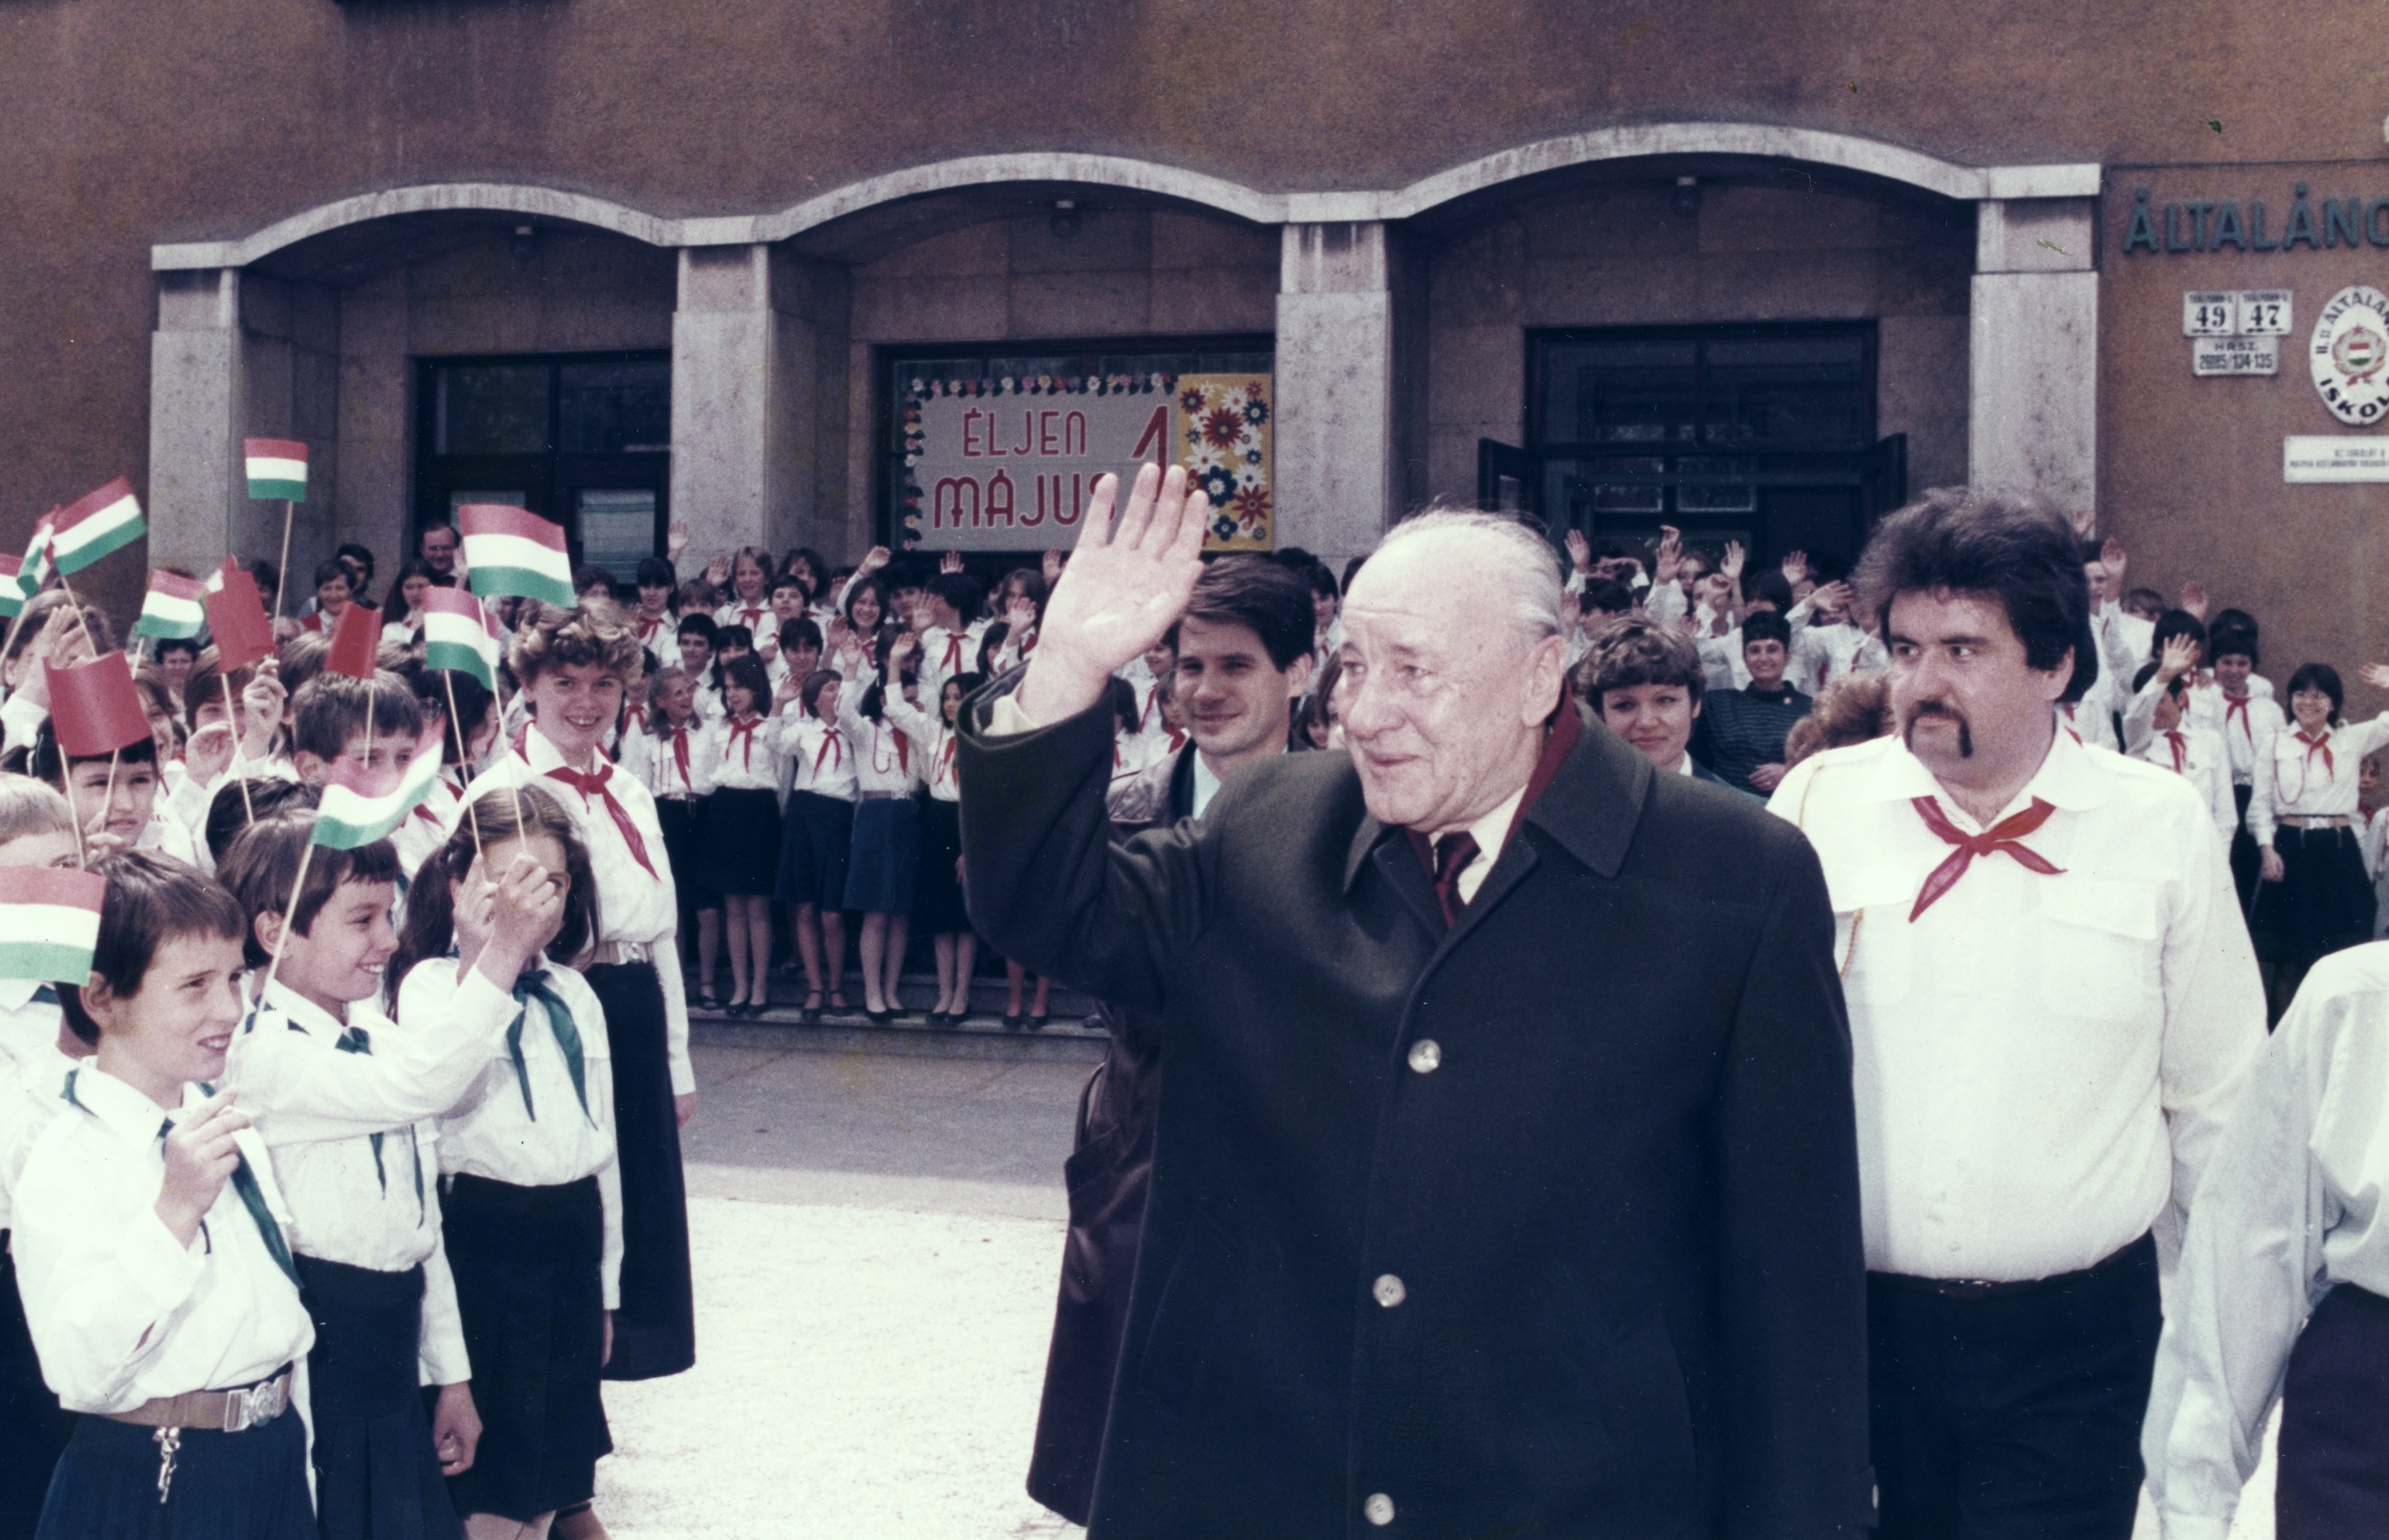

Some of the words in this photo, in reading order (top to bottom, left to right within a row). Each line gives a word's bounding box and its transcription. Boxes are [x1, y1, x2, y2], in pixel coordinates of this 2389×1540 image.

[2195, 305, 2226, 328] 49
[2250, 303, 2280, 327] 47
[2320, 375, 2389, 417] ISKOL
[962, 406, 1088, 458] ÉLJEN
[1132, 404, 1168, 503] 1
